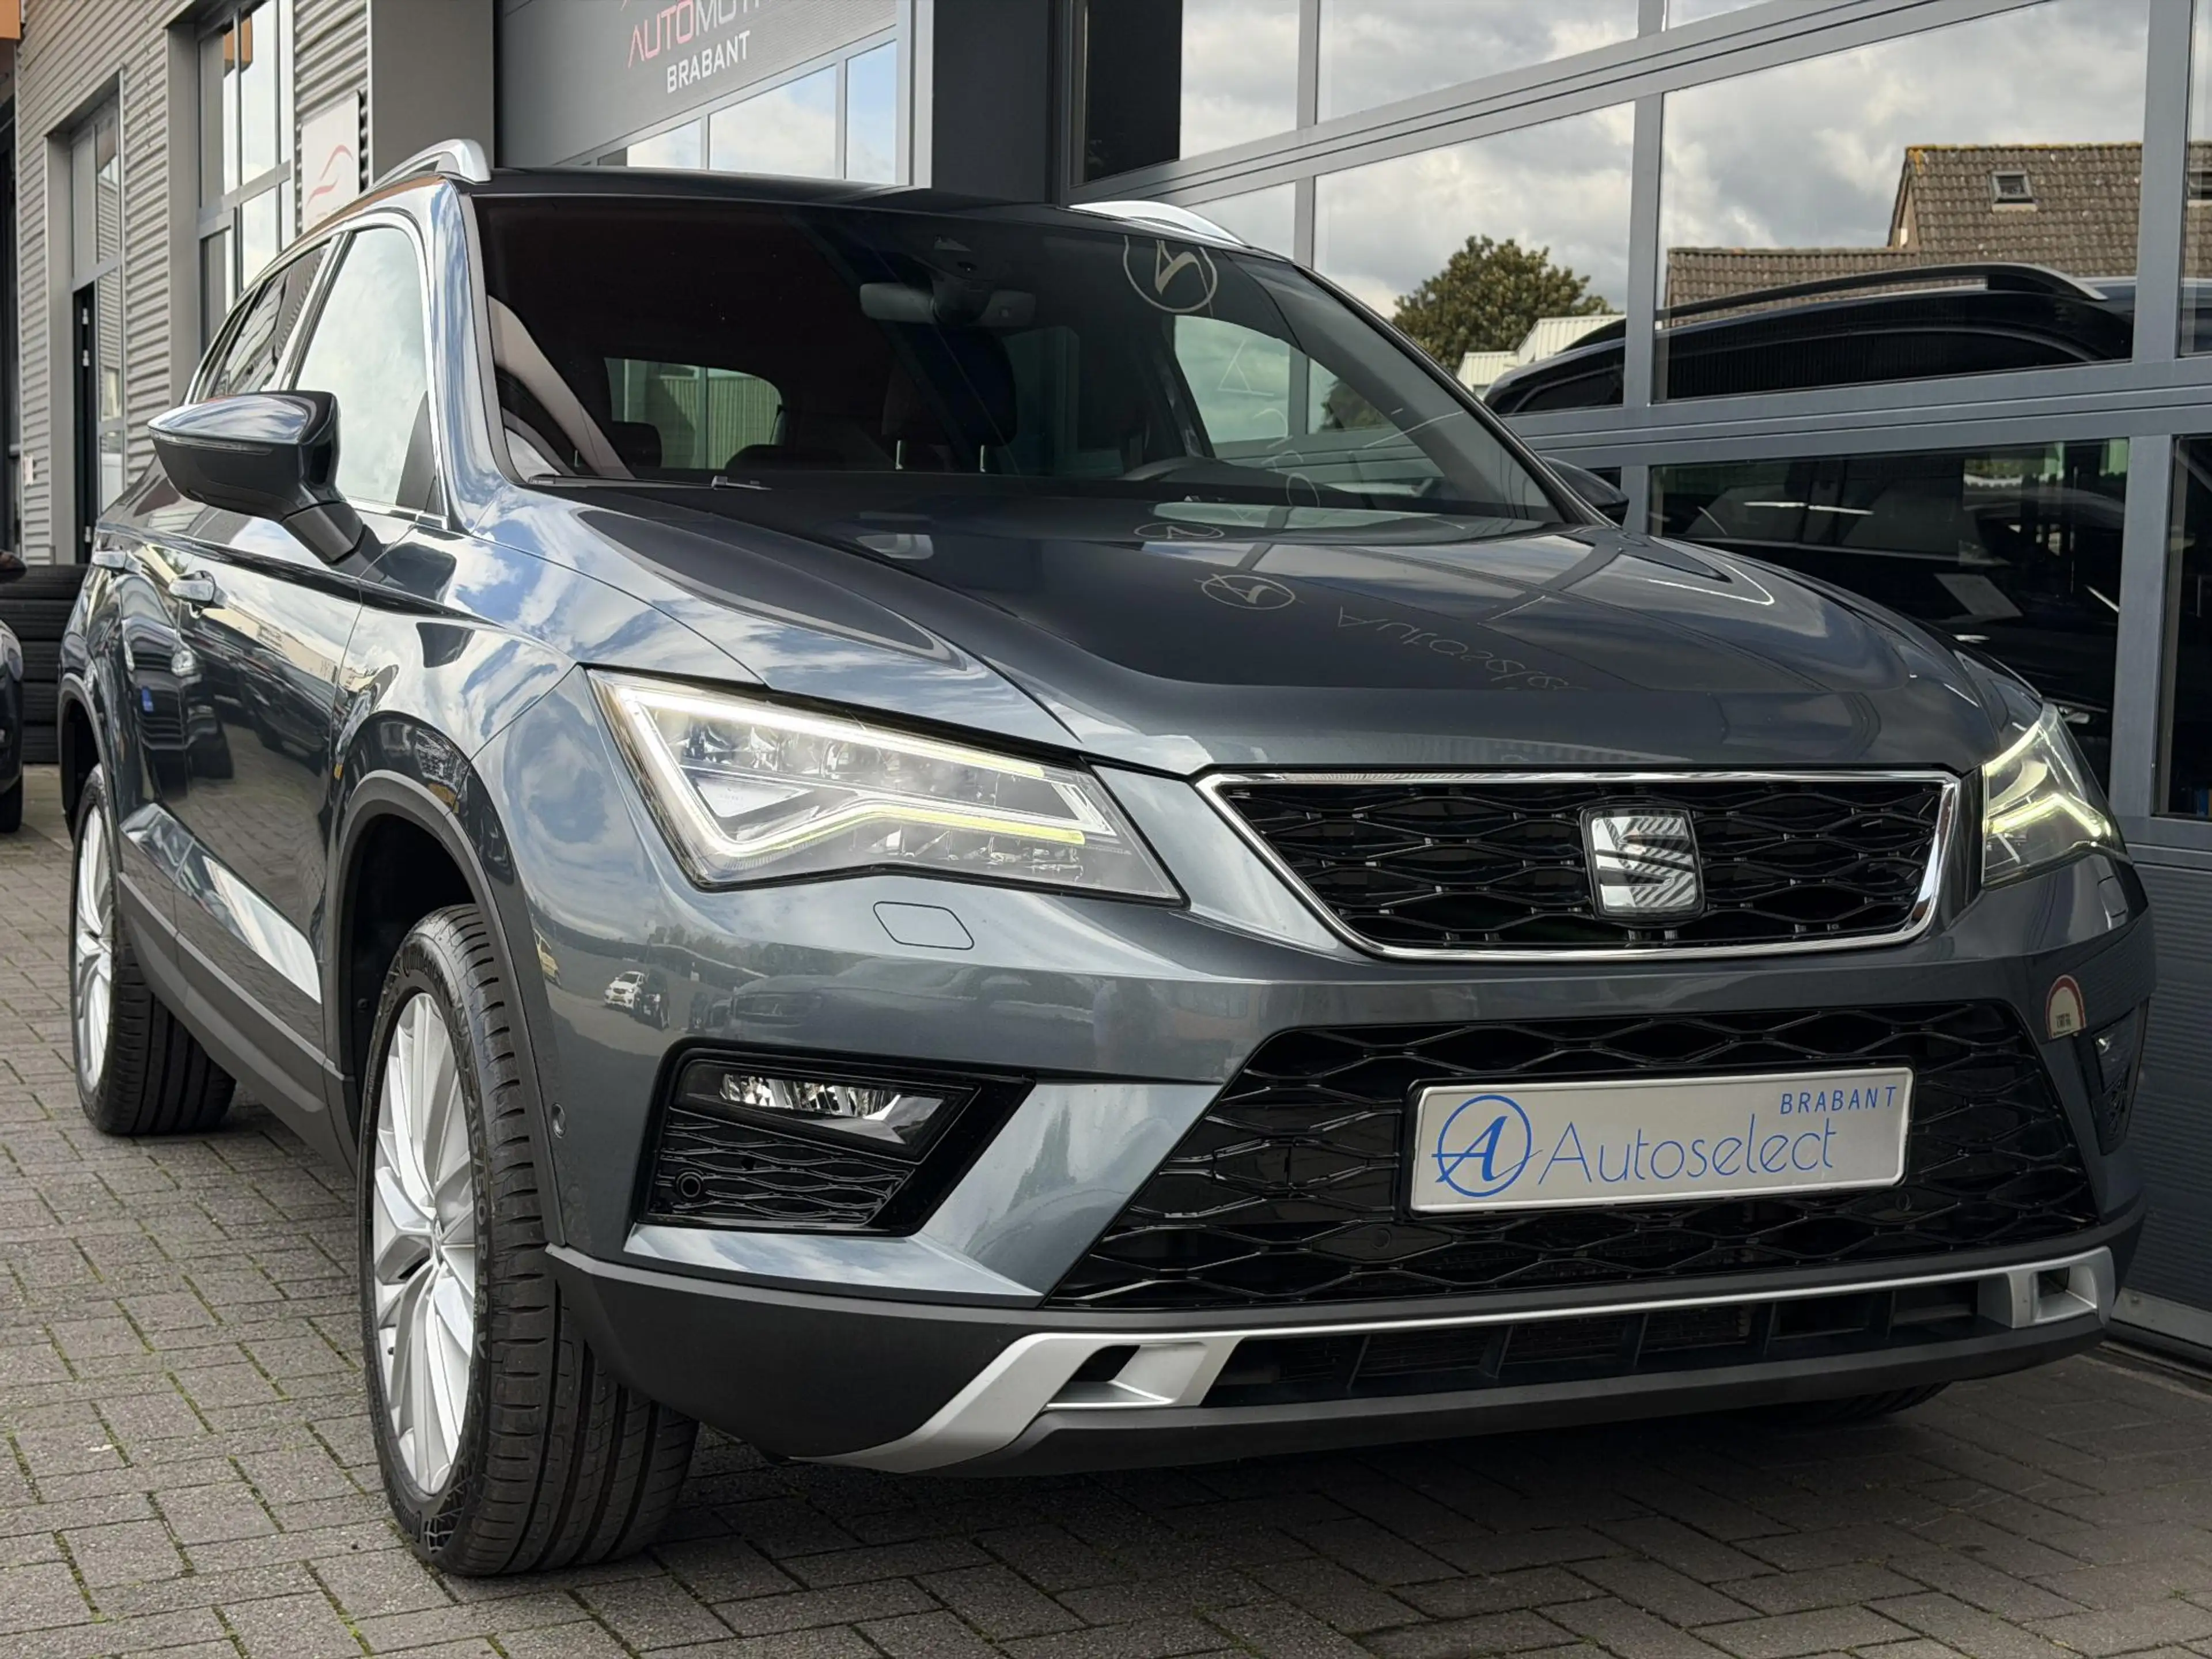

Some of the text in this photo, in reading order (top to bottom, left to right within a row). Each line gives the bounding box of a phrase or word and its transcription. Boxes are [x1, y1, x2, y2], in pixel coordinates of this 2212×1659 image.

[628, 0, 759, 69] AUTOMO
[666, 30, 751, 94] BRABANT
[1780, 1086, 1897, 1115] BRABANT
[1537, 1113, 1839, 1185] Autoselect
